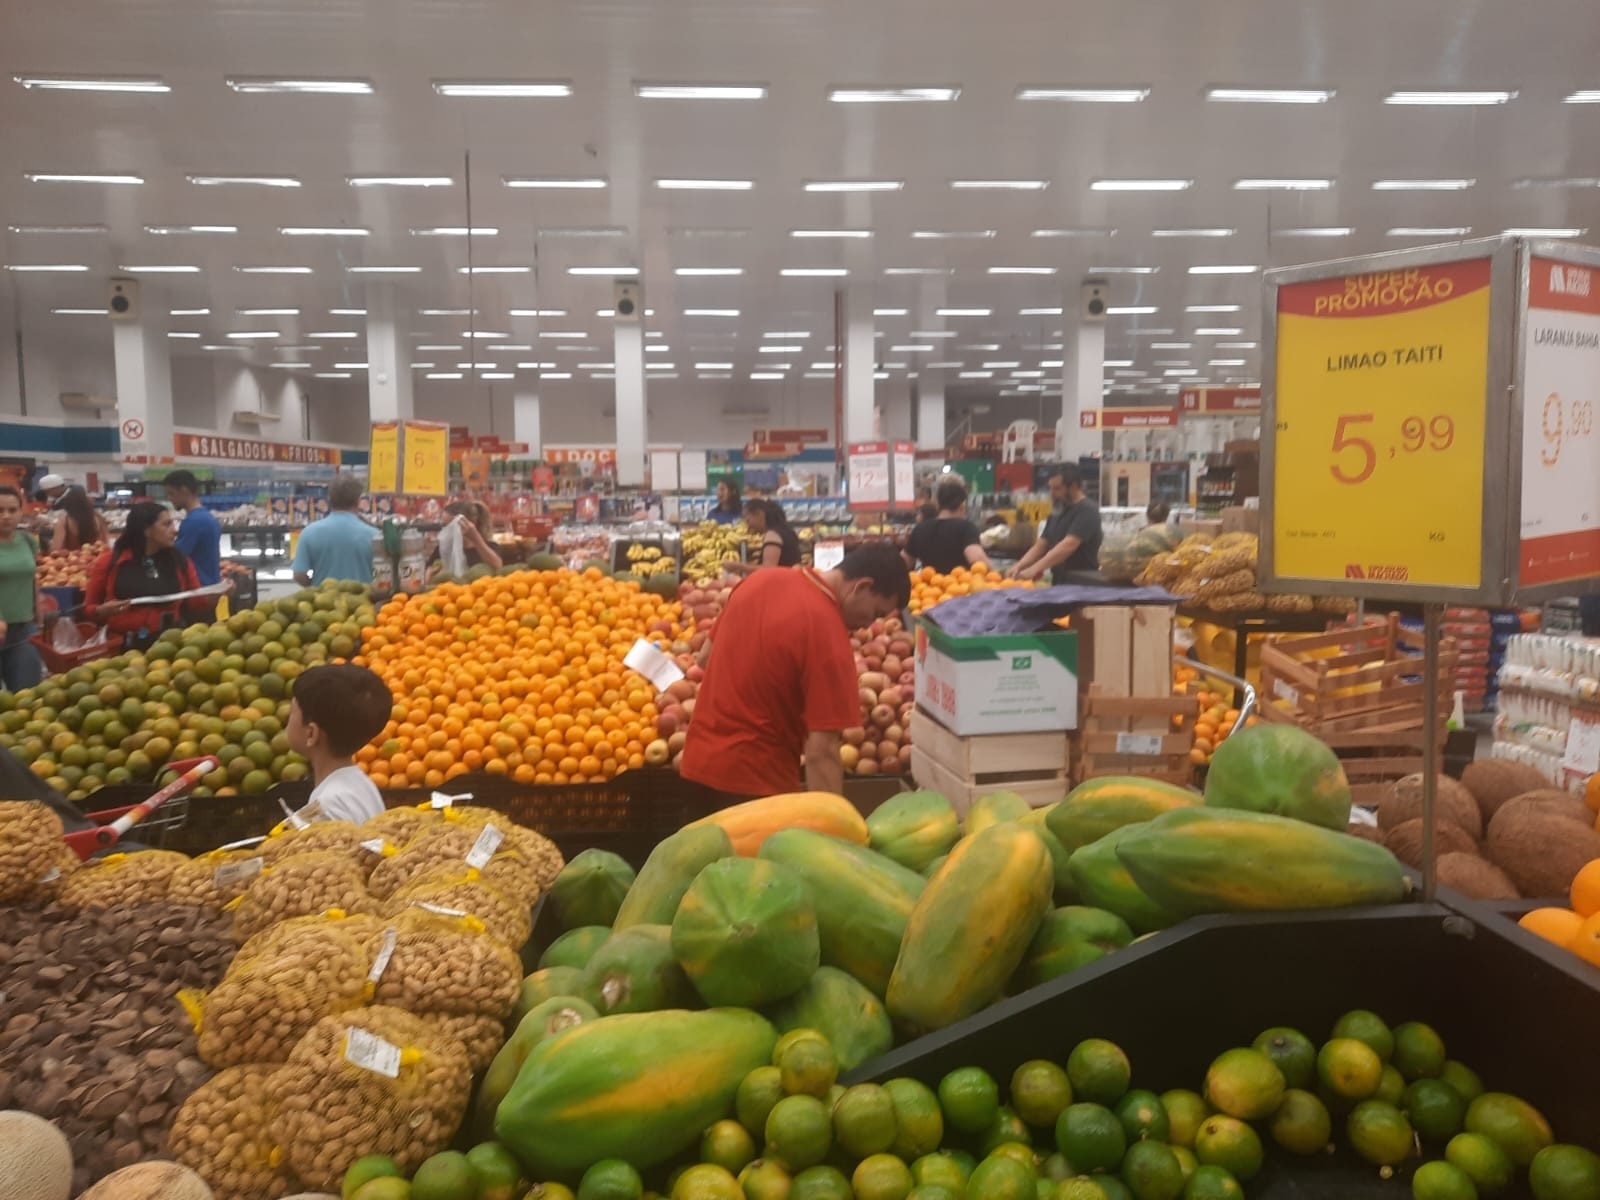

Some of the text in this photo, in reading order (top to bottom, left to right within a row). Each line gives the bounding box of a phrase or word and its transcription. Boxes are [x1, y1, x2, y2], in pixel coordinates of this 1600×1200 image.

[1314, 276, 1454, 315] PROMOÇÃO
[1344, 269, 1420, 293] SUPER
[1326, 344, 1444, 373] LIMAO TAITI
[200, 437, 320, 463] SALGADOS FRIOS
[1330, 412, 1456, 486] 5,99
